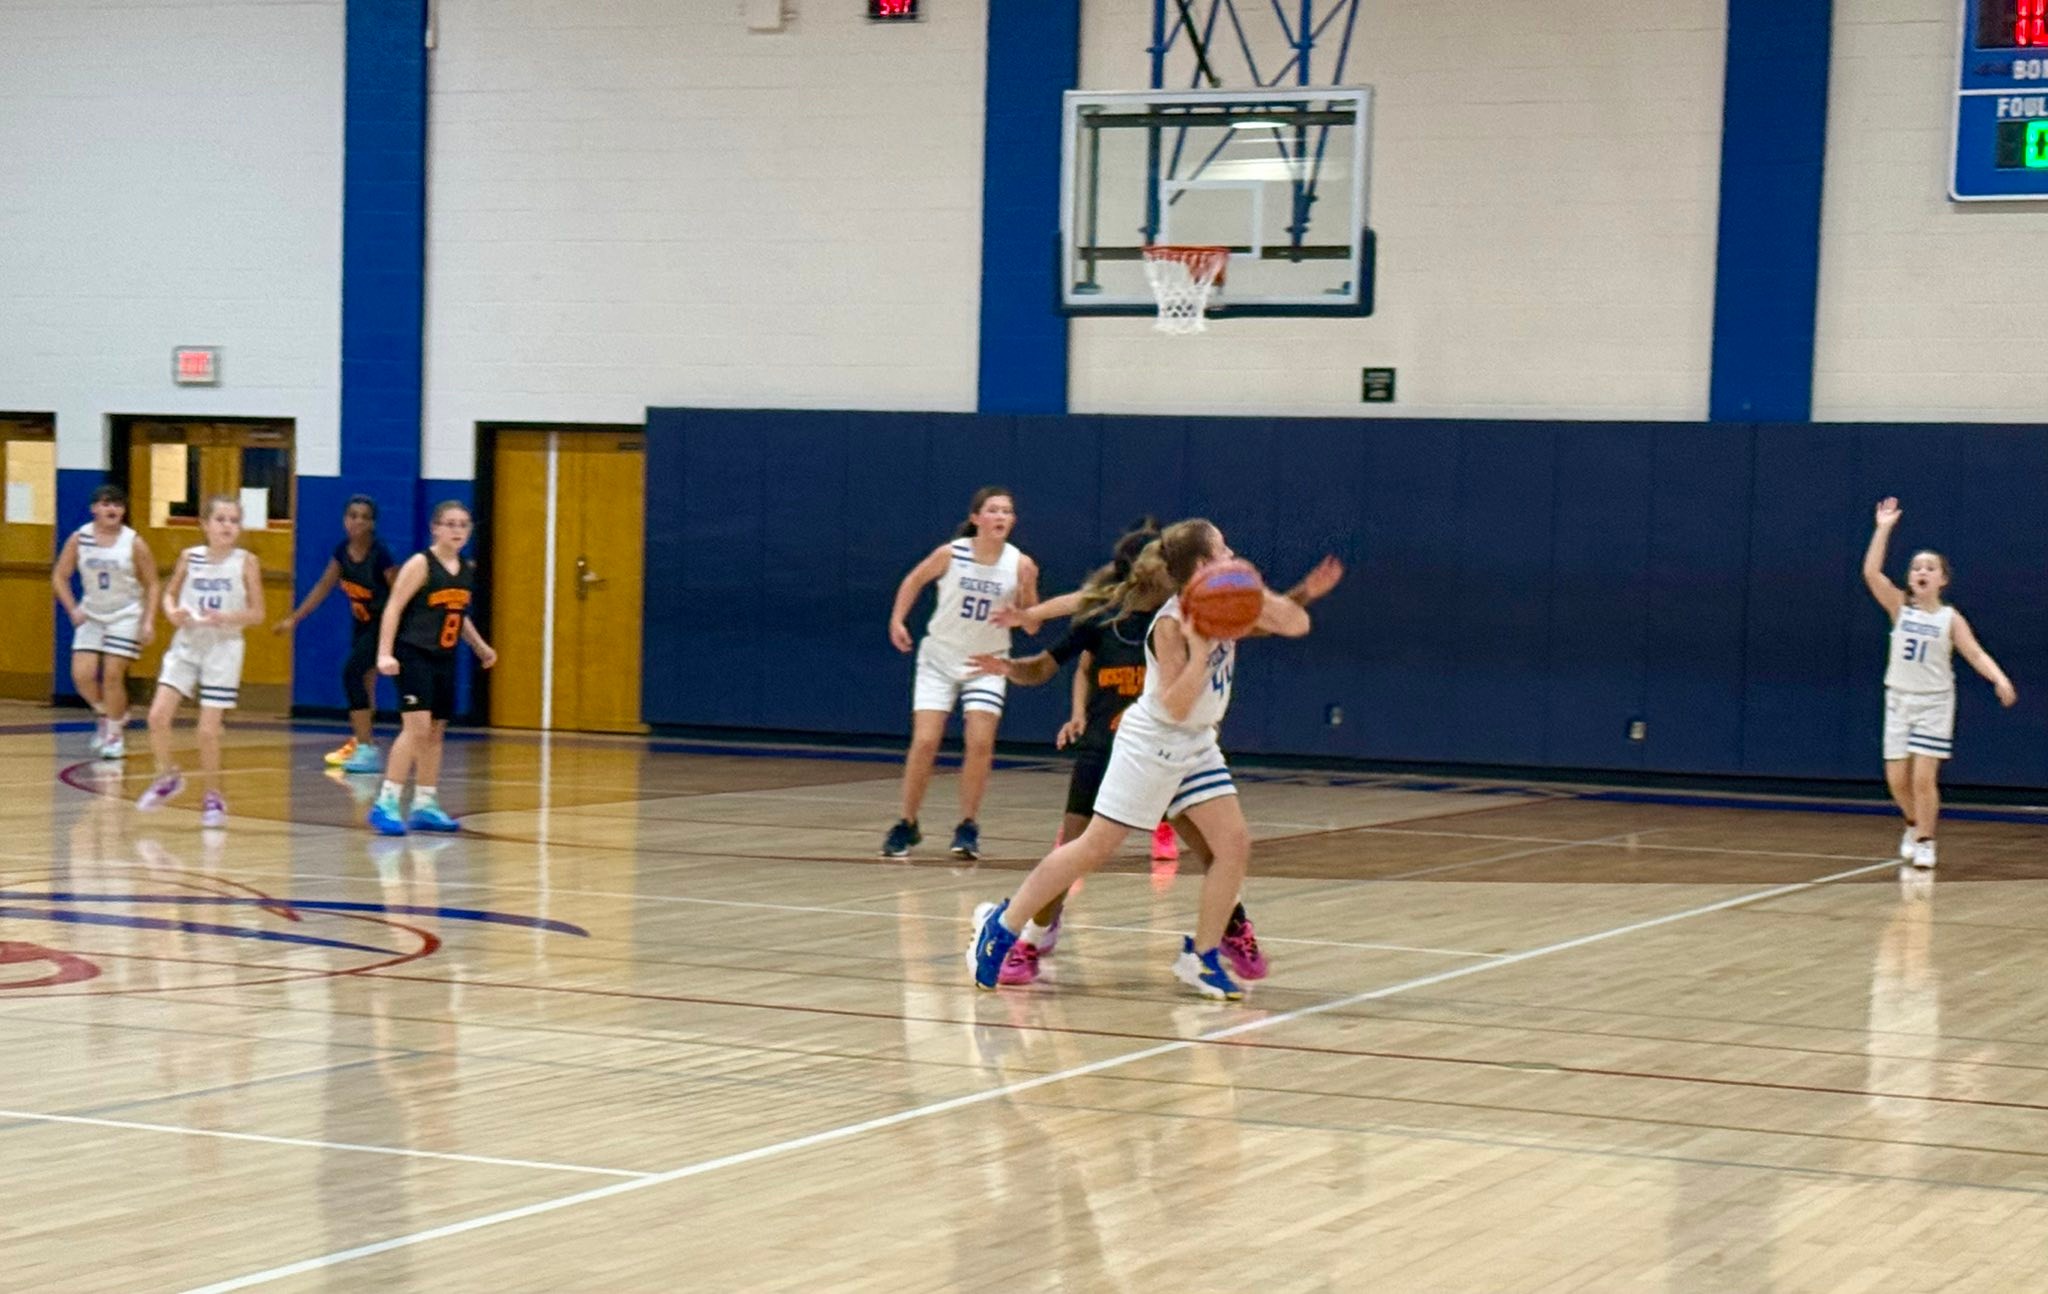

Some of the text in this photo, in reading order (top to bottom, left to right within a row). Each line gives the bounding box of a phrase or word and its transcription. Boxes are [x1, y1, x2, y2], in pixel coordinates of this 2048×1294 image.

[960, 595, 992, 622] 50
[440, 612, 462, 650] 8
[1903, 638, 1928, 663] 31
